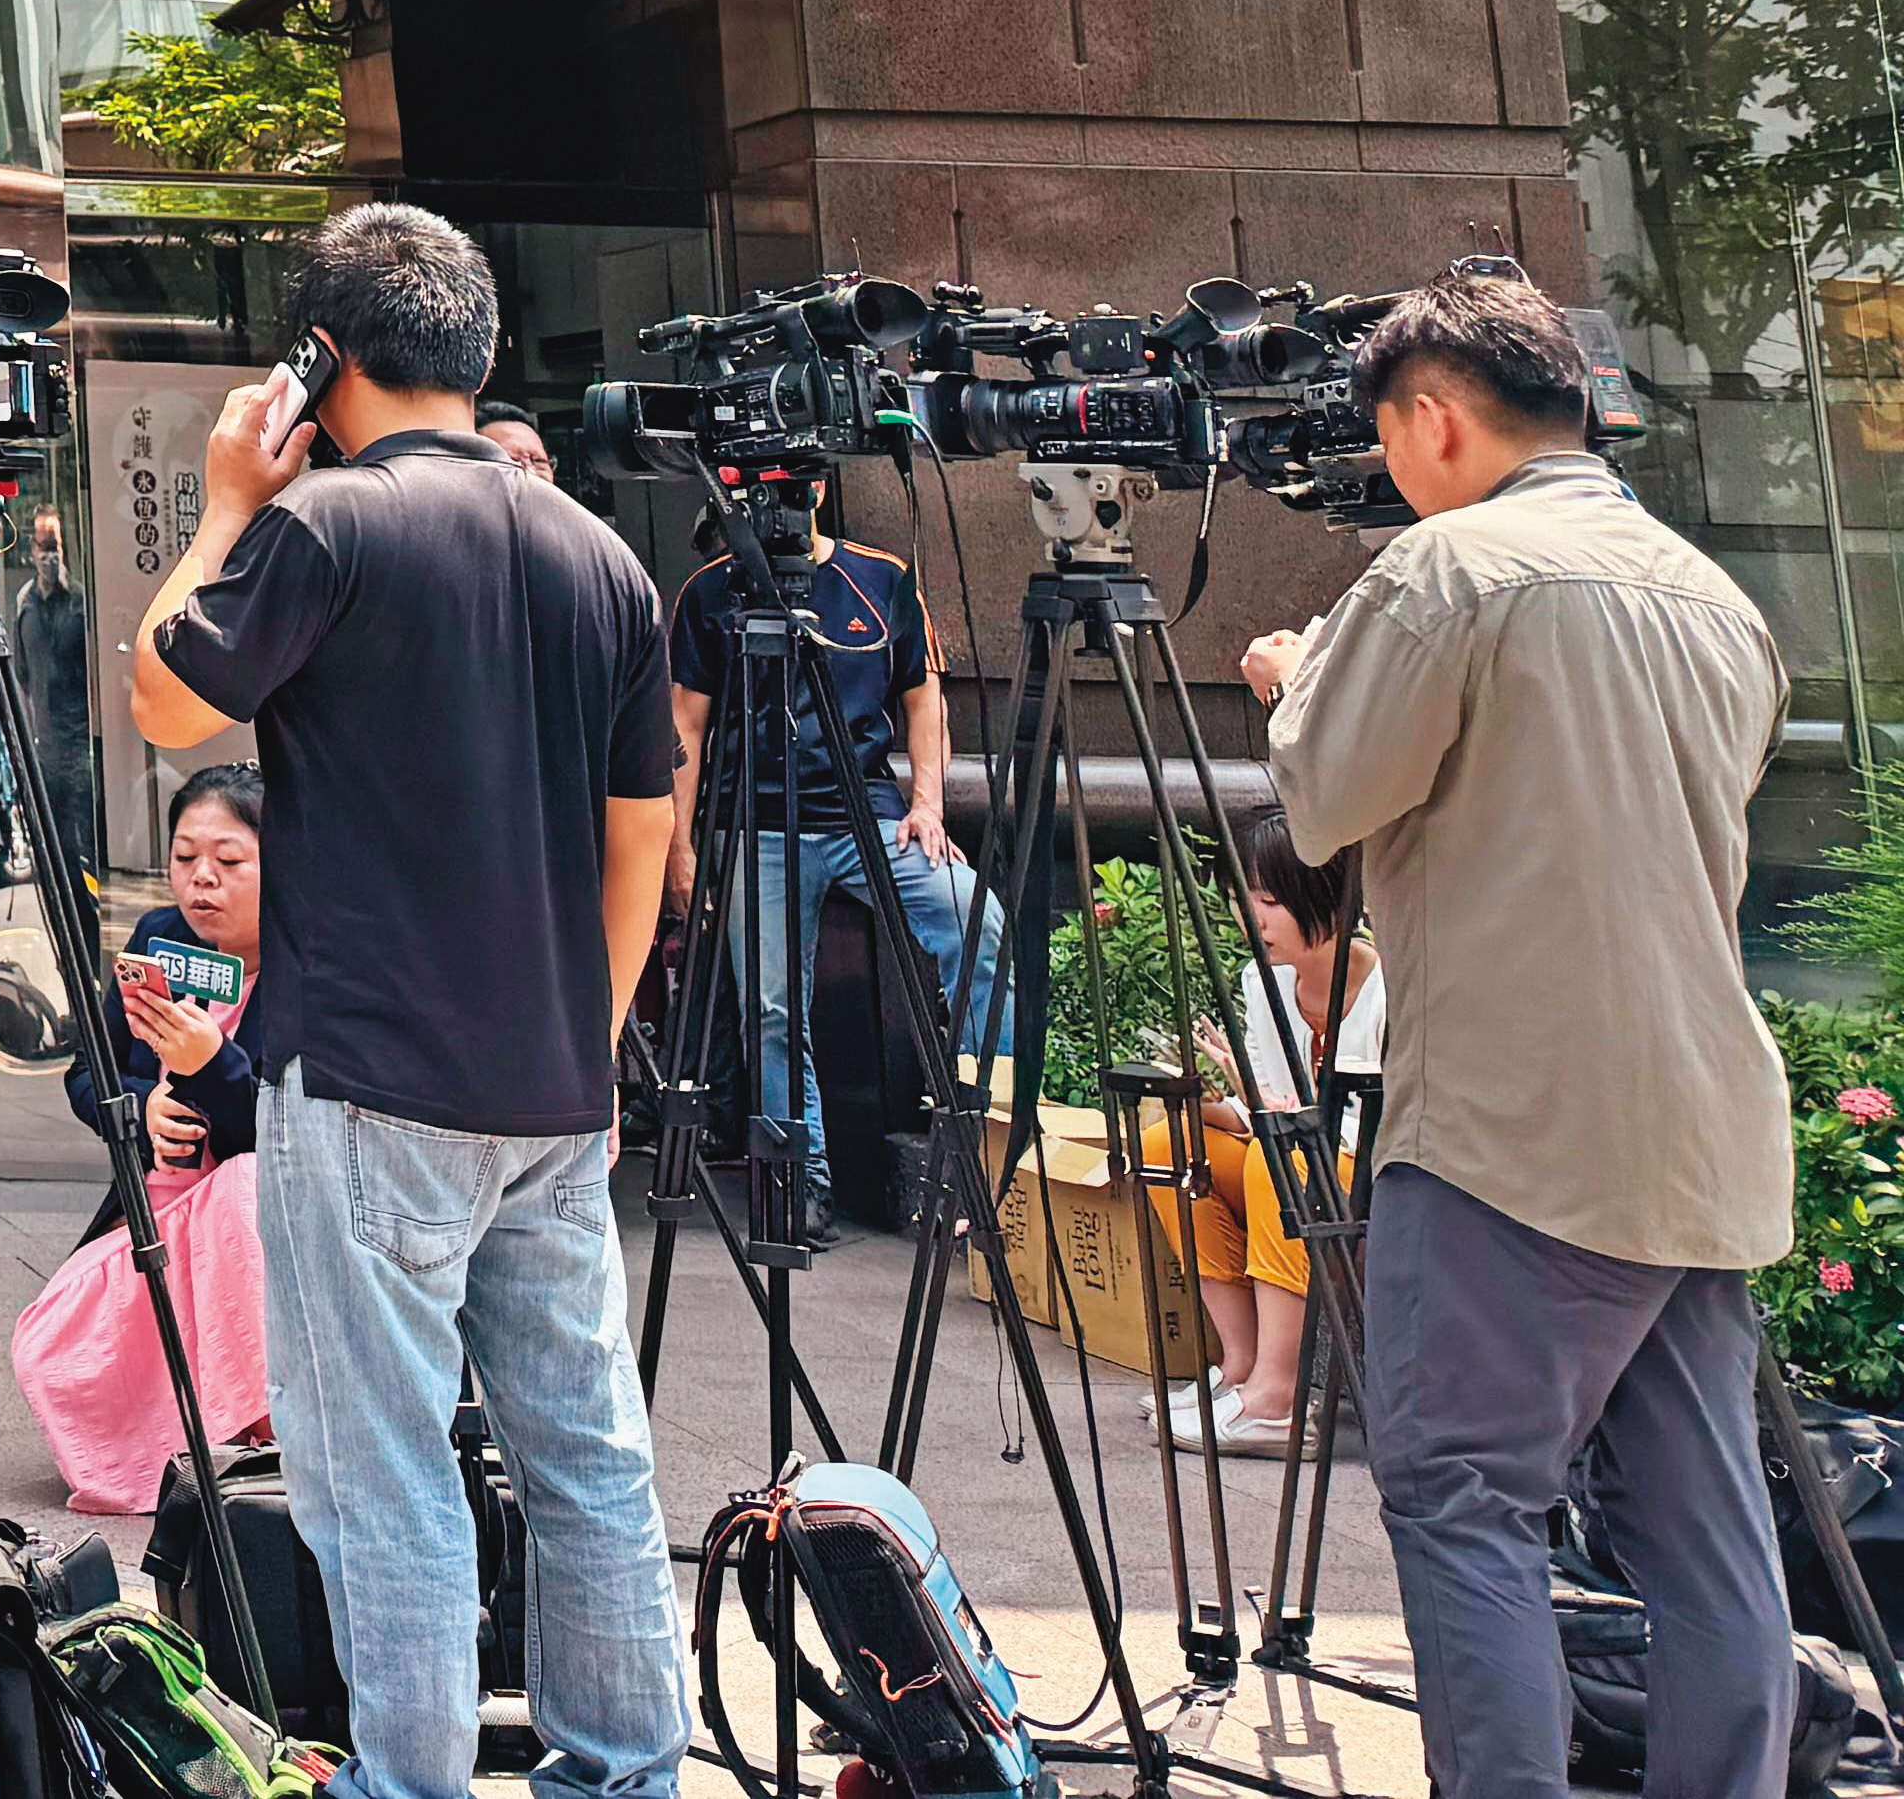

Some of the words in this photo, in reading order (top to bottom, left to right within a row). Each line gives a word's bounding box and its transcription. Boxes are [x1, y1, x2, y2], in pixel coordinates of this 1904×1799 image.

[187, 955, 235, 997] 華視
[1072, 1208, 1087, 1275] Baby
[1083, 1211, 1106, 1292] Long
